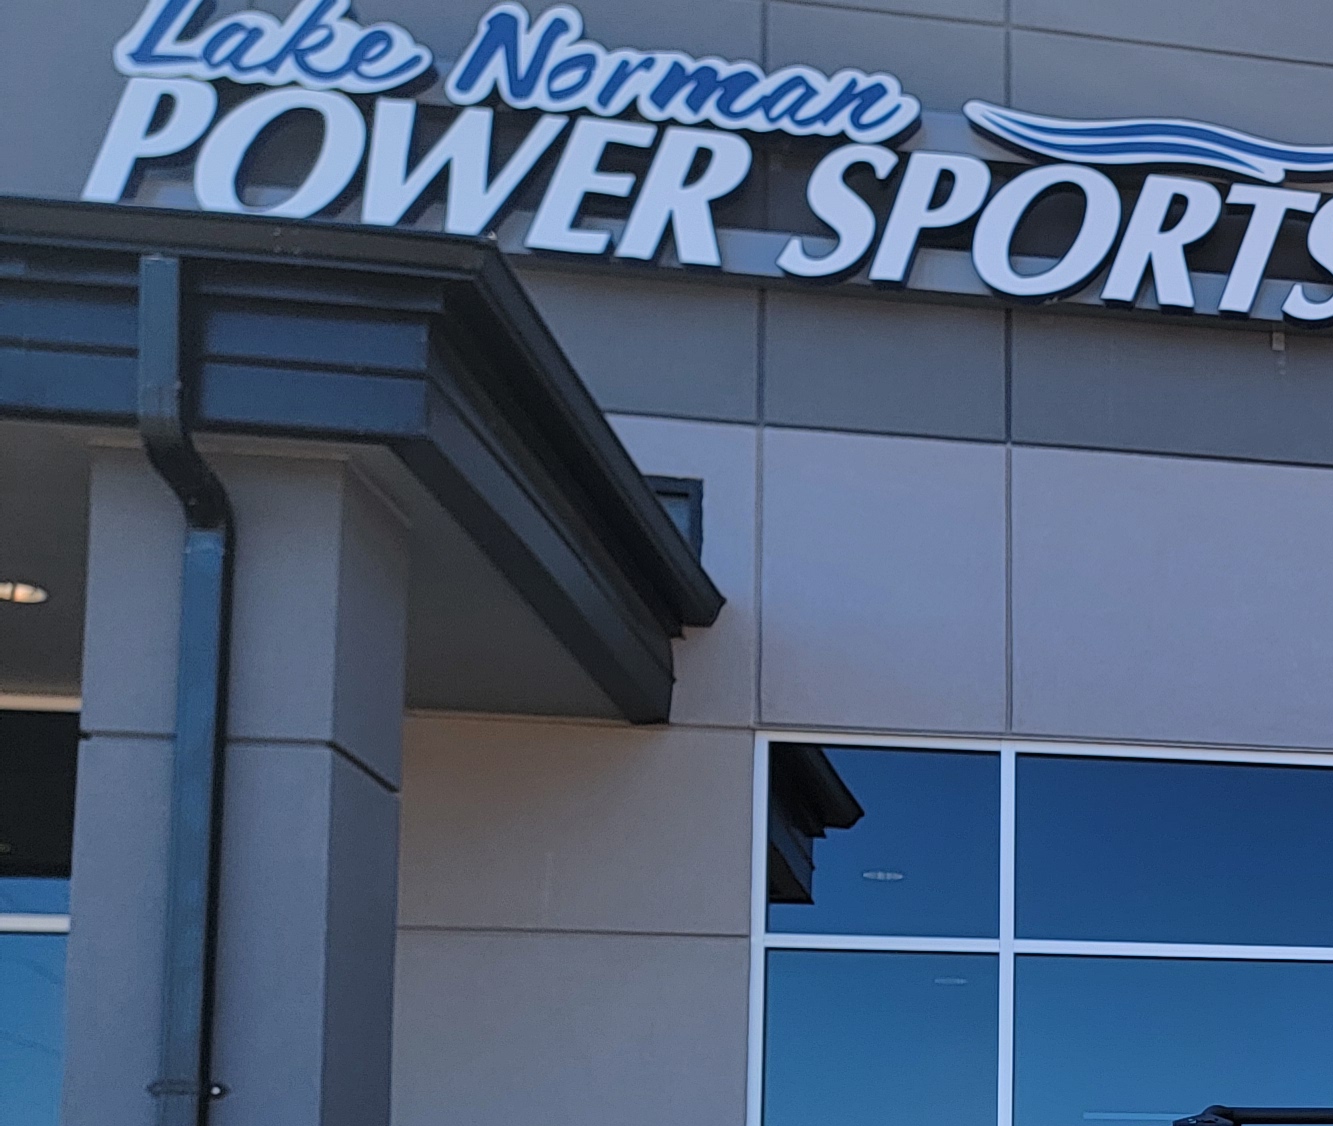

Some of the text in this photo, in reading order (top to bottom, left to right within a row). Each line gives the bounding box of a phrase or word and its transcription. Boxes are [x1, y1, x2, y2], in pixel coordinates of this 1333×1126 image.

[115, 0, 920, 141] Lake Norman
[81, 76, 753, 266] POWER
